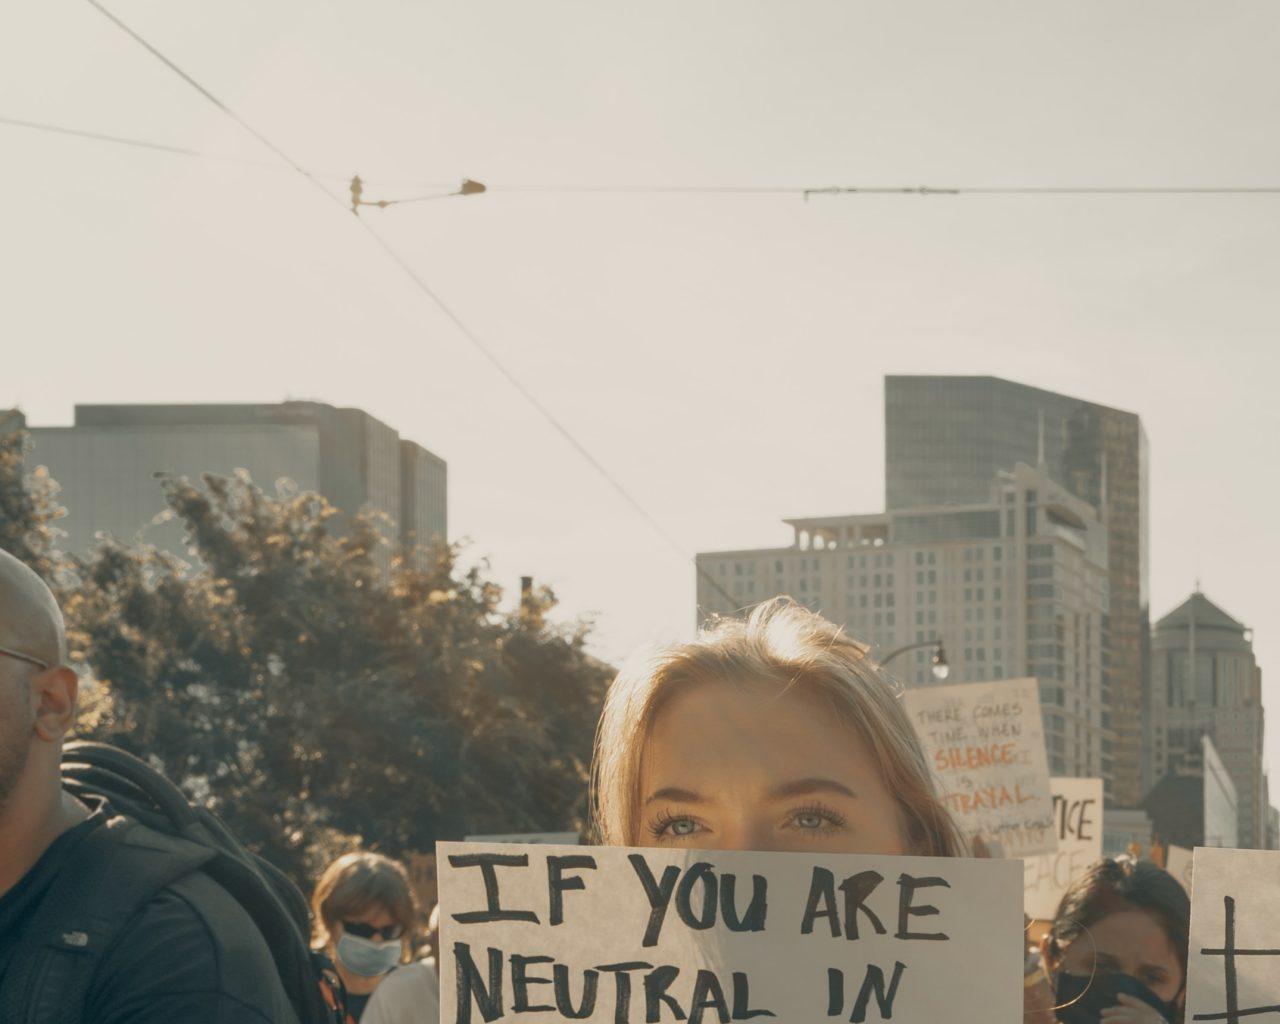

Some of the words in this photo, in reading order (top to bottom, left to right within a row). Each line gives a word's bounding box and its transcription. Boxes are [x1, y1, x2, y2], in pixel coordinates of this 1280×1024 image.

[917, 702, 964, 726] THERE
[972, 702, 1024, 721] COMES
[978, 722, 1022, 741] WHEN
[934, 742, 1017, 772] SILENCE
[940, 782, 1036, 816] TRAYAL
[1024, 849, 1086, 892] ACE
[447, 852, 598, 927] IF
[627, 853, 768, 948] YOU
[800, 865, 952, 942] ARE
[827, 961, 908, 1024] IN
